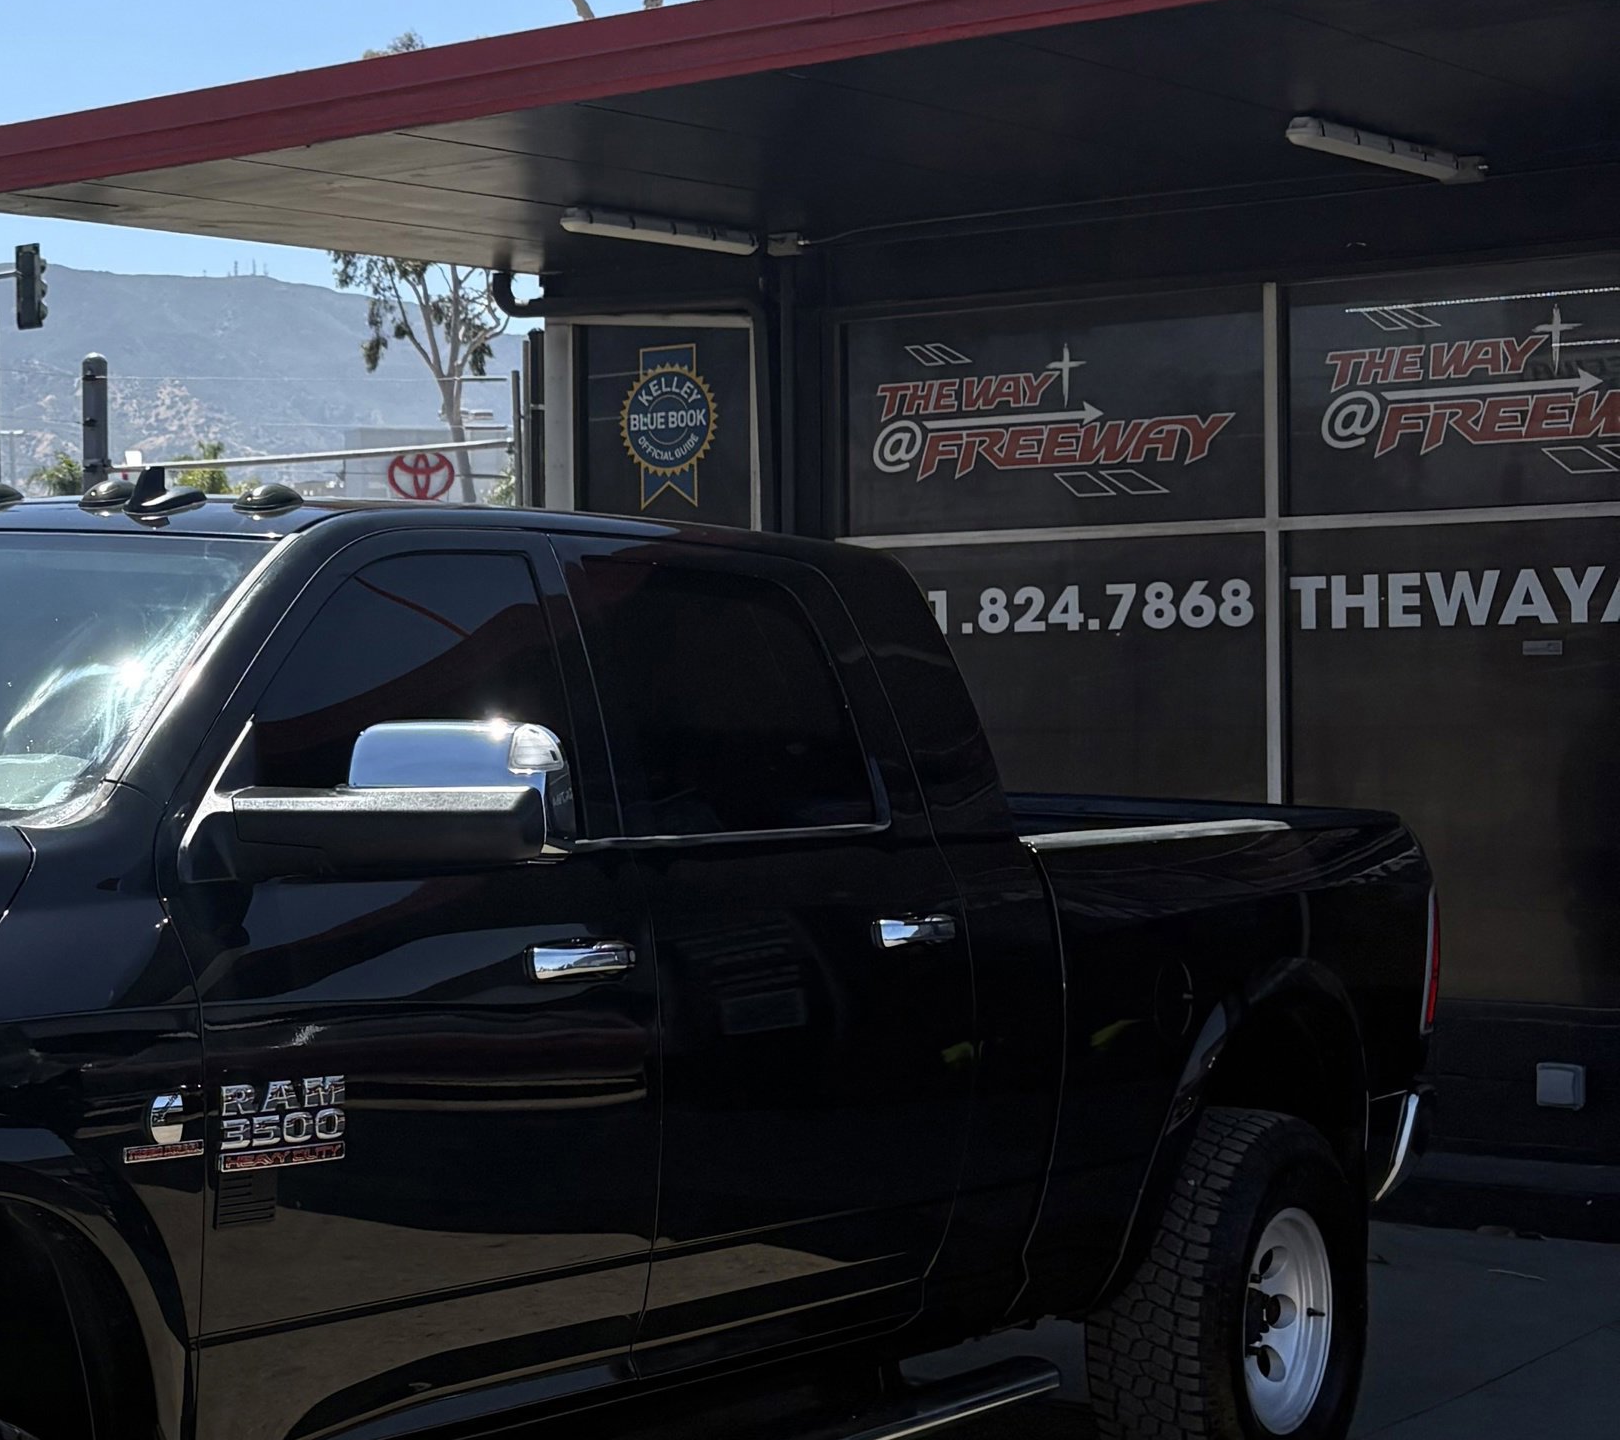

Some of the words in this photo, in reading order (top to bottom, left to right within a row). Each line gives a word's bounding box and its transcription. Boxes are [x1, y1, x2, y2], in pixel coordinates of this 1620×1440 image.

[1325, 345, 1425, 393] THE
[1429, 334, 1550, 381] WAY
[638, 376, 701, 406] KELLEY
[876, 377, 960, 422] THE
[961, 370, 1062, 412] WAY
[630, 412, 666, 431] BLUE
[668, 408, 707, 429] BOOK
[638, 436, 674, 461] OFFICIAL
[674, 433, 699, 459] GUIDE
[220, 1075, 346, 1116] RAM
[220, 1108, 346, 1150] 3500
[226, 1150, 291, 1168] HEAVY
[291, 1143, 342, 1162] DUTY
